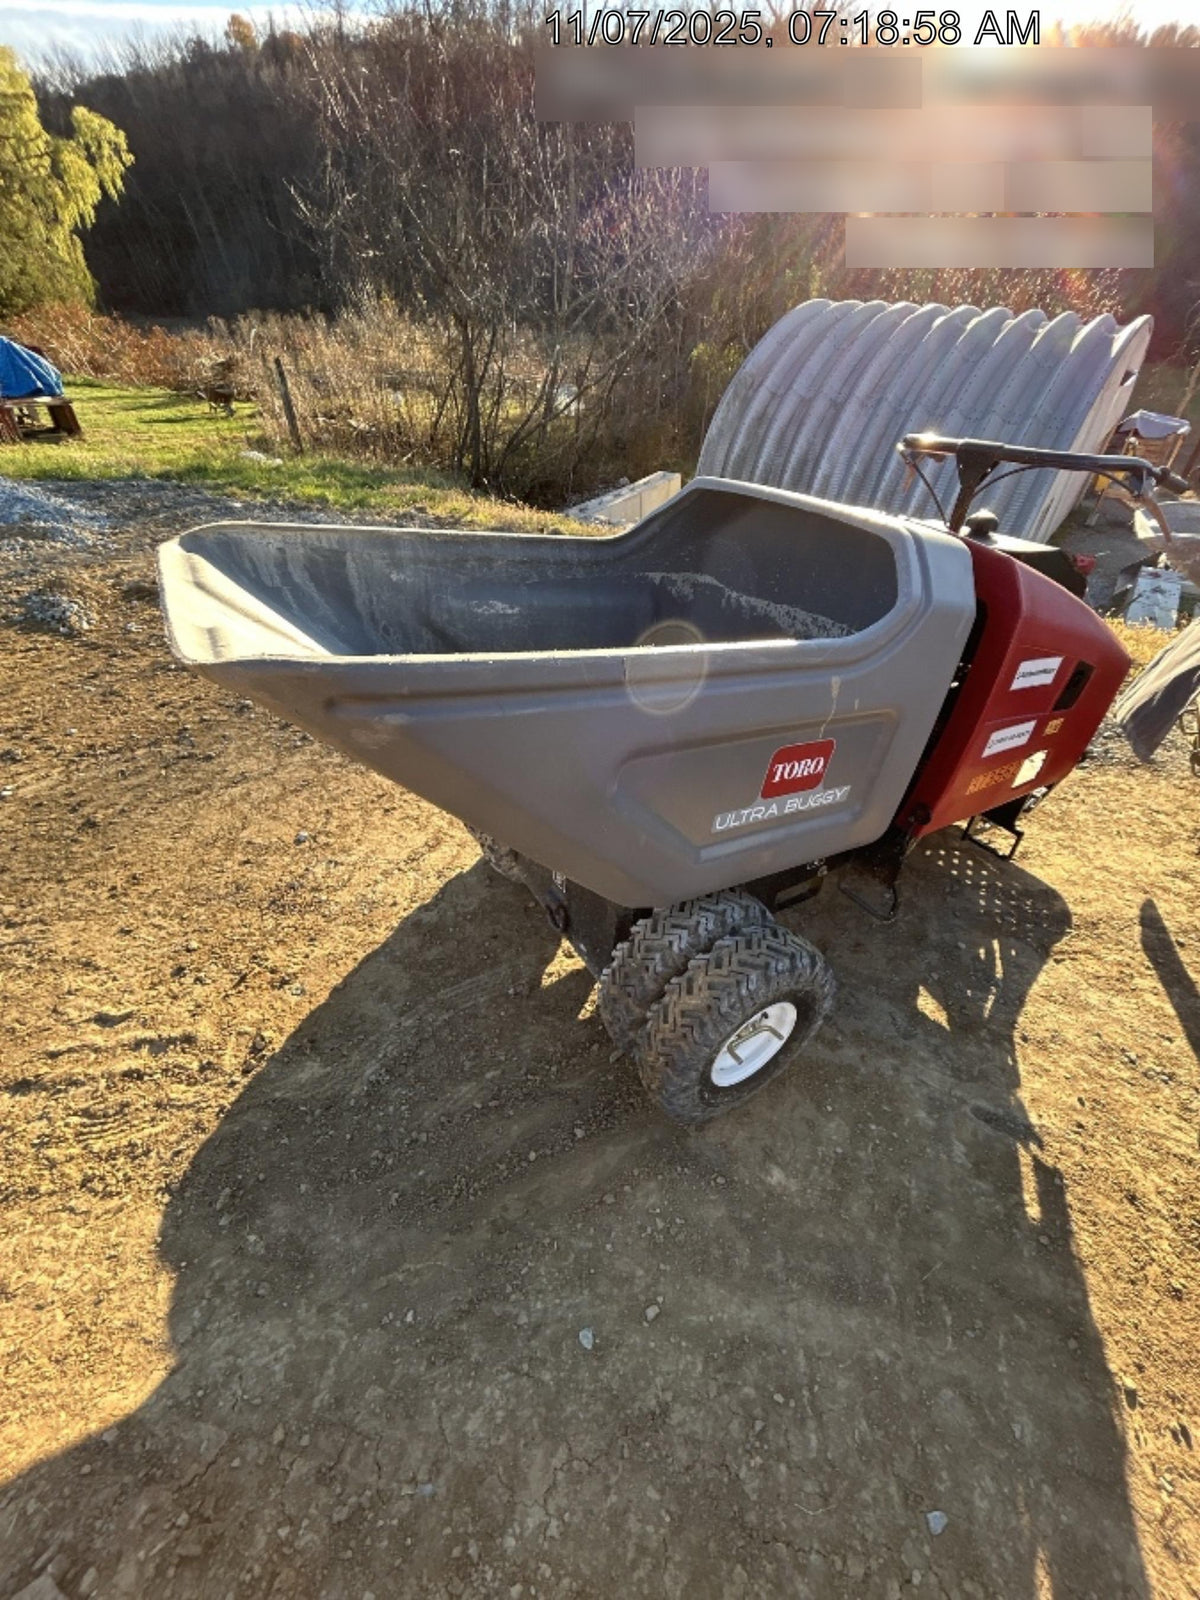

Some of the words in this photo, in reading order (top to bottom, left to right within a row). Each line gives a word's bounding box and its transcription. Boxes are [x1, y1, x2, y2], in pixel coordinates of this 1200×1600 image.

[771, 756, 825, 783] TORO
[714, 803, 778, 830] ULTRA
[784, 786, 849, 814] BUGGY
